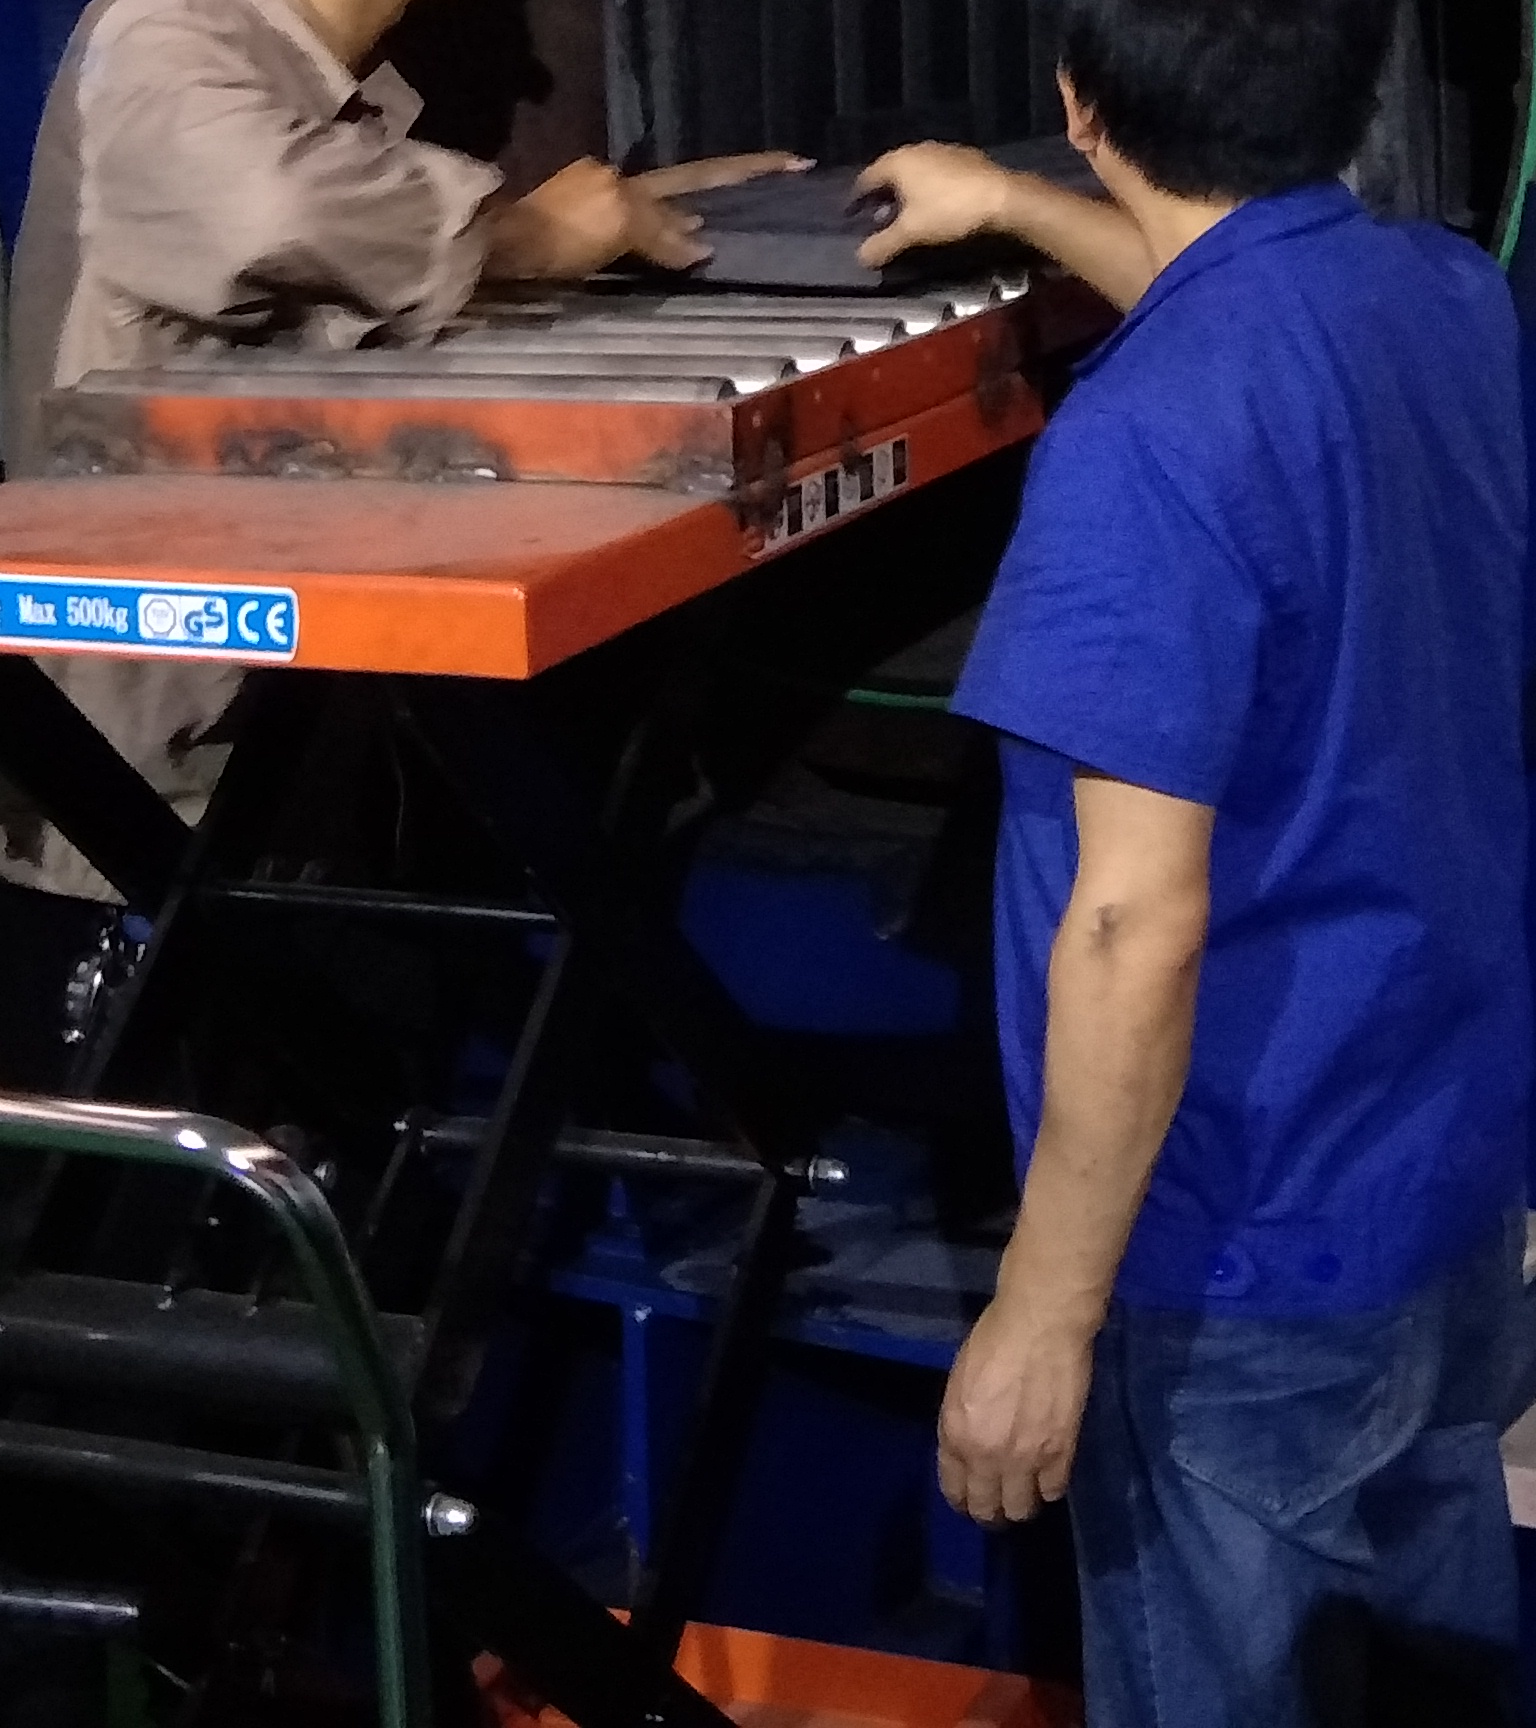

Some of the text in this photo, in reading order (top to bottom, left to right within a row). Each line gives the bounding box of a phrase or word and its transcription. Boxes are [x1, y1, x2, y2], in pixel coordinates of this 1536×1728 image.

[16, 593, 289, 645] Max 500kg GS CE
